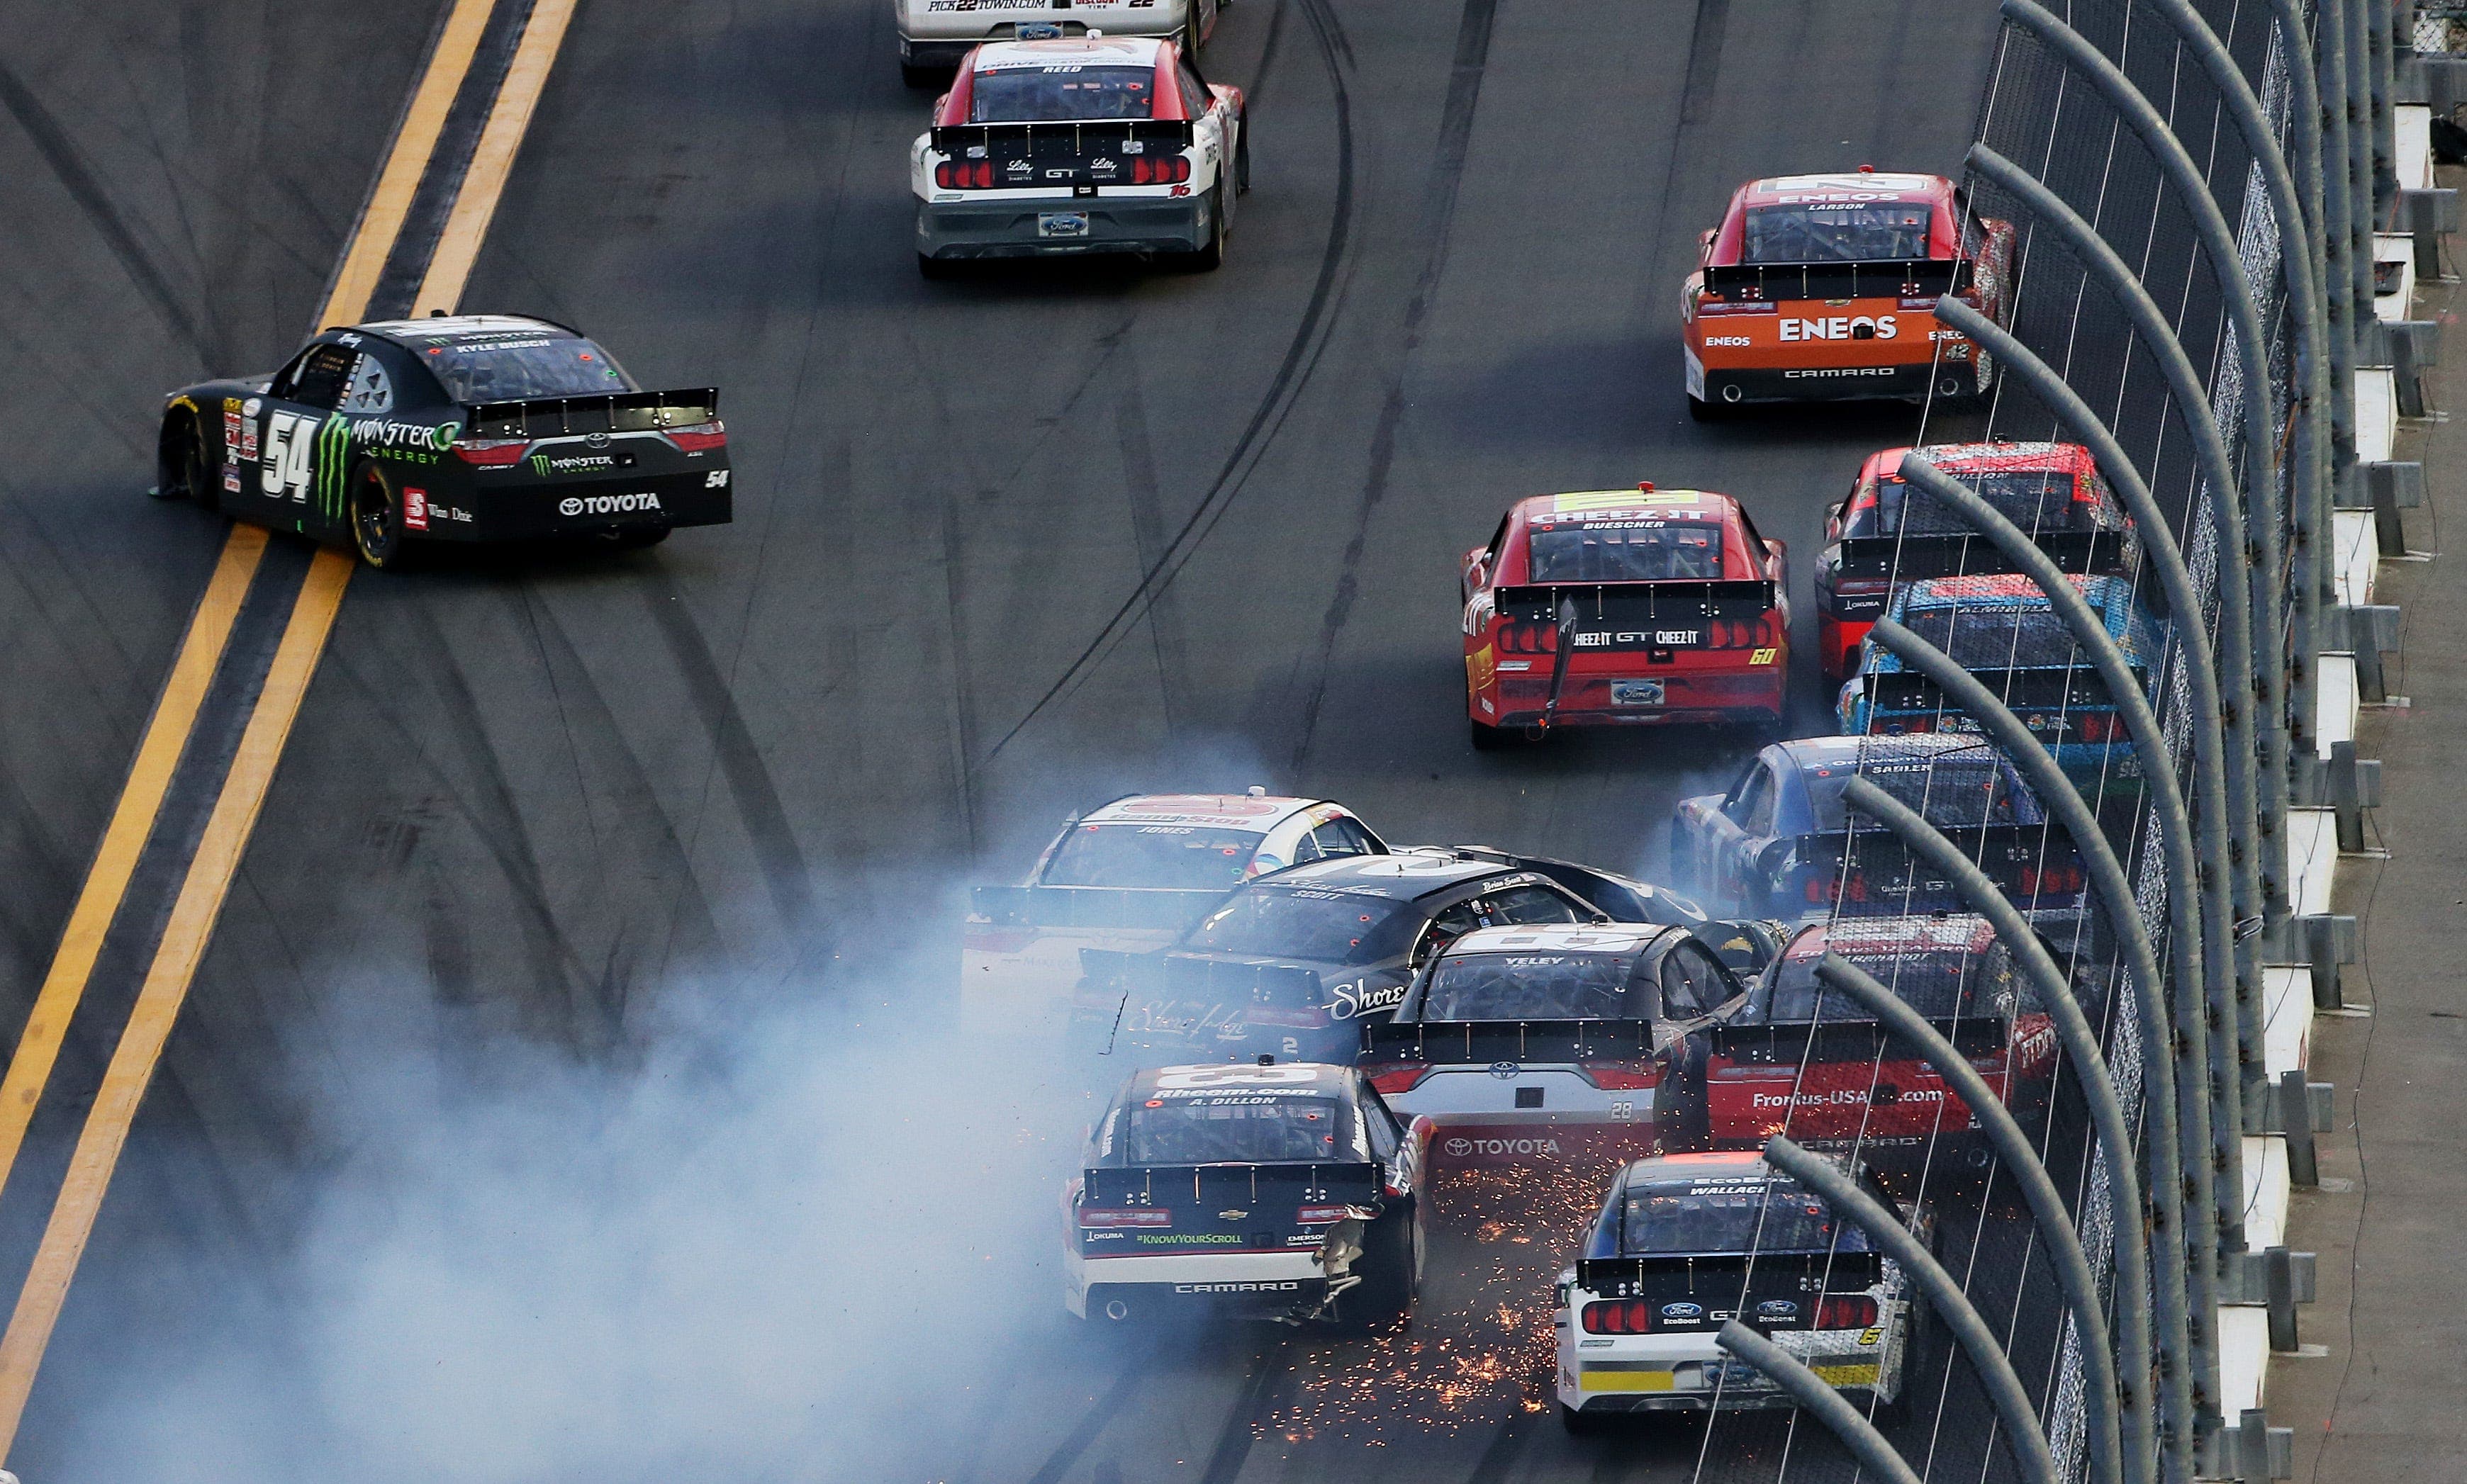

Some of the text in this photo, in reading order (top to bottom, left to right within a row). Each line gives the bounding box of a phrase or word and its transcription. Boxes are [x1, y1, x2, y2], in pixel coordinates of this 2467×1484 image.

[1007, 159, 1034, 174] Lilly
[1090, 157, 1117, 172] Lilly
[1046, 169, 1080, 179] GT
[1168, 184, 1191, 198] 16
[1779, 193, 1900, 203] ENEOS
[1050, 220, 1076, 230] Ford
[456, 344, 496, 354] KYLE
[498, 339, 551, 350] BUSCH
[1706, 337, 1751, 347] ENEOS
[1784, 368, 1895, 378] CAMARO
[262, 408, 322, 504] 54
[371, 446, 439, 465] ENERGY
[551, 456, 614, 468] MONSTER
[705, 469, 729, 488] 54
[583, 493, 661, 515] TOYOTA
[1582, 521, 1666, 530] BUESCHER
[1616, 631, 1652, 642] GT
[1749, 648, 1777, 665] 60
[1623, 687, 1652, 698] Ford
[1136, 826, 1195, 835] JONES
[1291, 889, 1345, 901] SCOTT
[1321, 978, 1404, 1021] Shore
[1282, 1036, 1299, 1055] 2
[1152, 1089, 1319, 1098] Rheem.com
[1189, 1097, 1277, 1106] A. DILLON
[1610, 1101, 1633, 1120] 28
[1473, 1138, 1560, 1154] TOYOTA
[1690, 1186, 1767, 1196] WALLACE
[1175, 1282, 1299, 1293] CAMARO
[1669, 1306, 1694, 1315] Ford
[1764, 1304, 1790, 1312] Ford
[1858, 1327, 1885, 1345] 6
